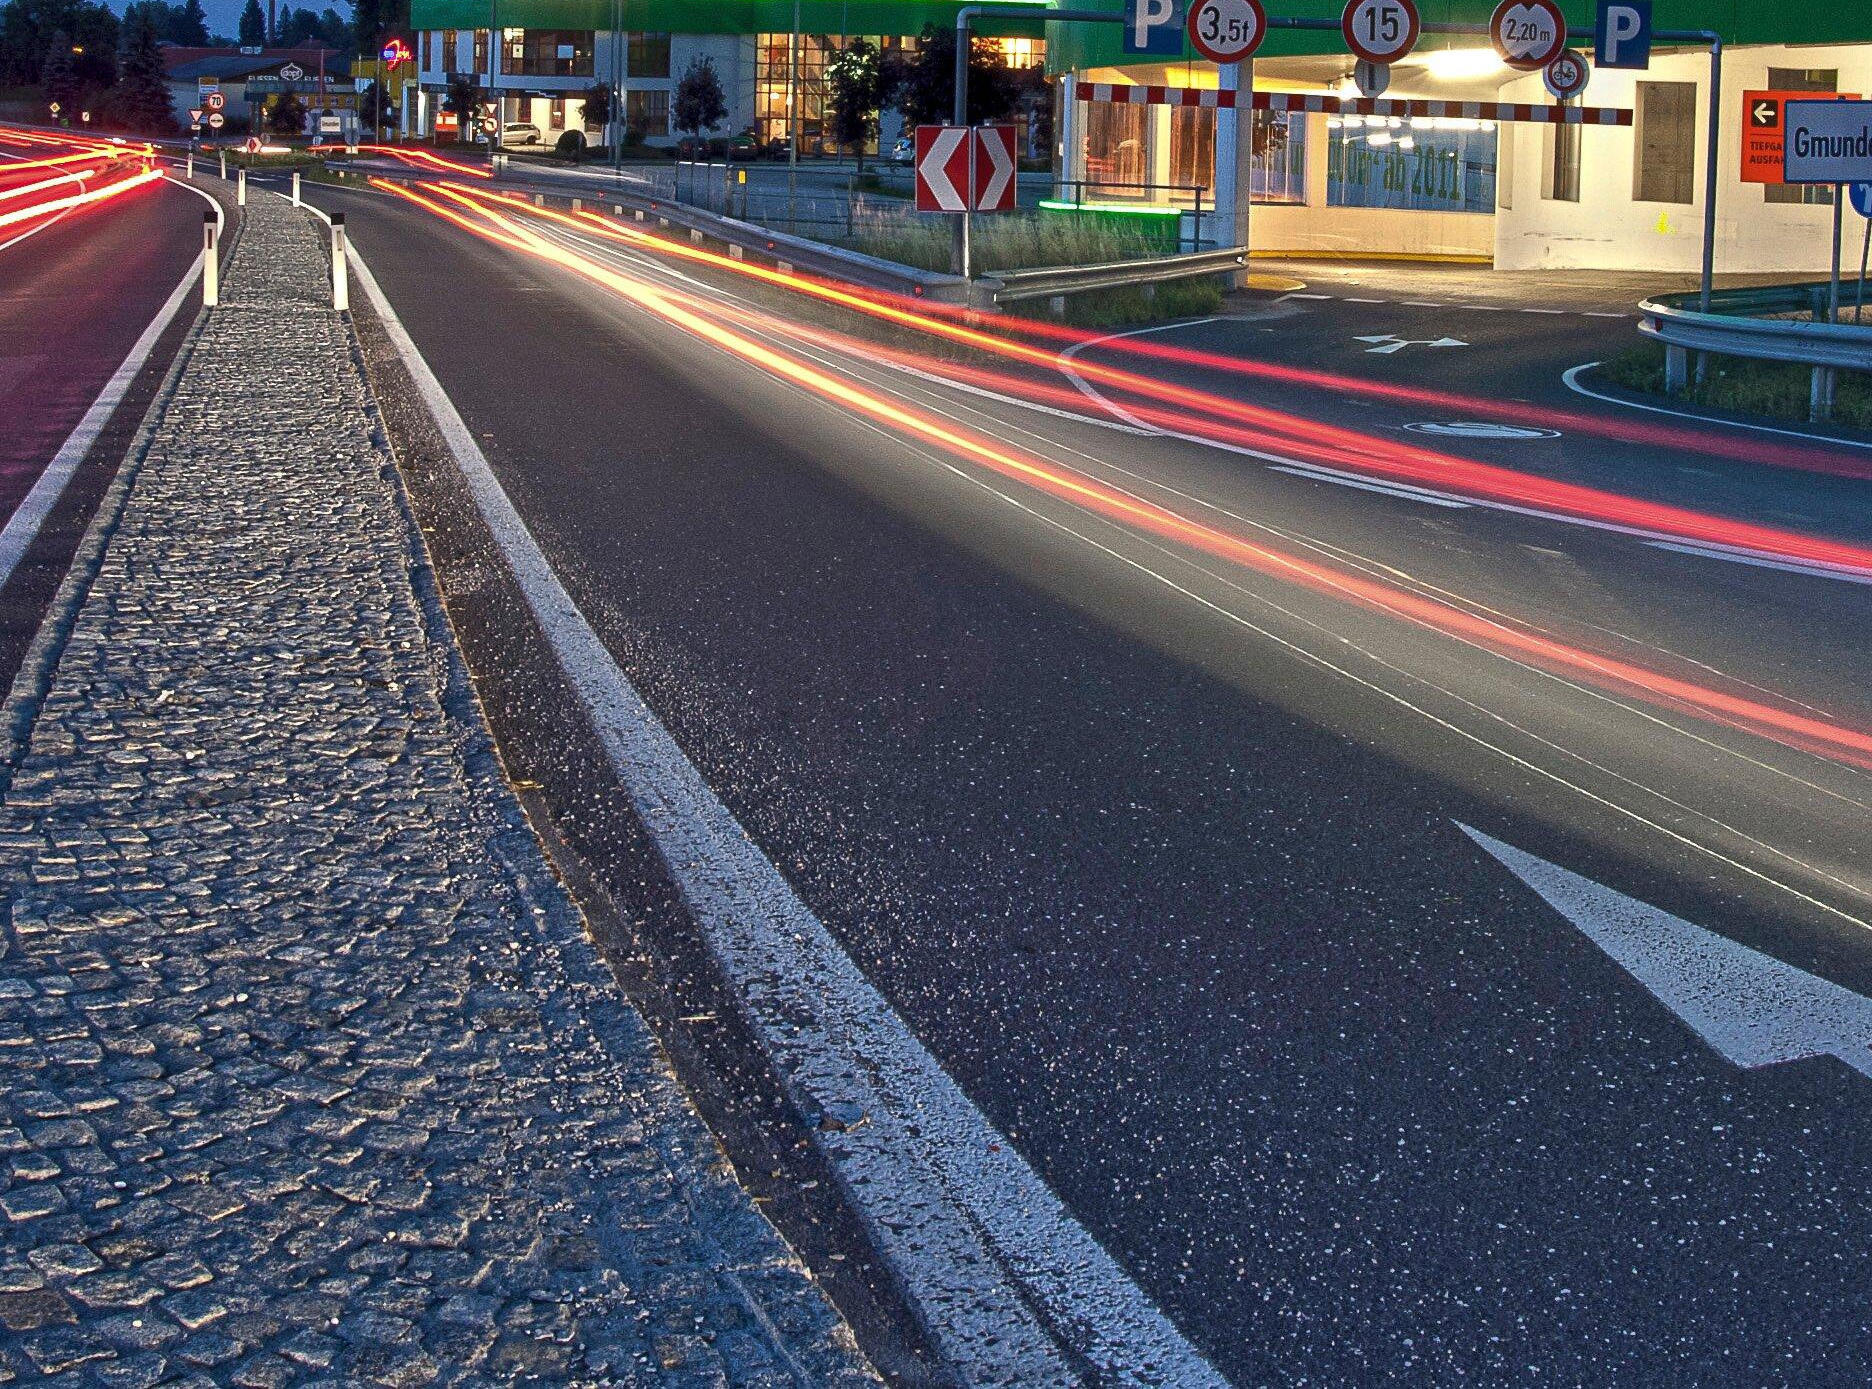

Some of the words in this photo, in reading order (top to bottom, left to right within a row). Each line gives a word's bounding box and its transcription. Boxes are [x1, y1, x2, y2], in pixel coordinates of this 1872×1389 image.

[1202, 6, 1249, 45] 3,5t
[1365, 7, 1399, 42] 15
[1507, 18, 1537, 42] 2,20
[1605, 6, 1640, 63] P
[212, 96, 222, 106] 70
[1412, 144, 1460, 201] 2011
